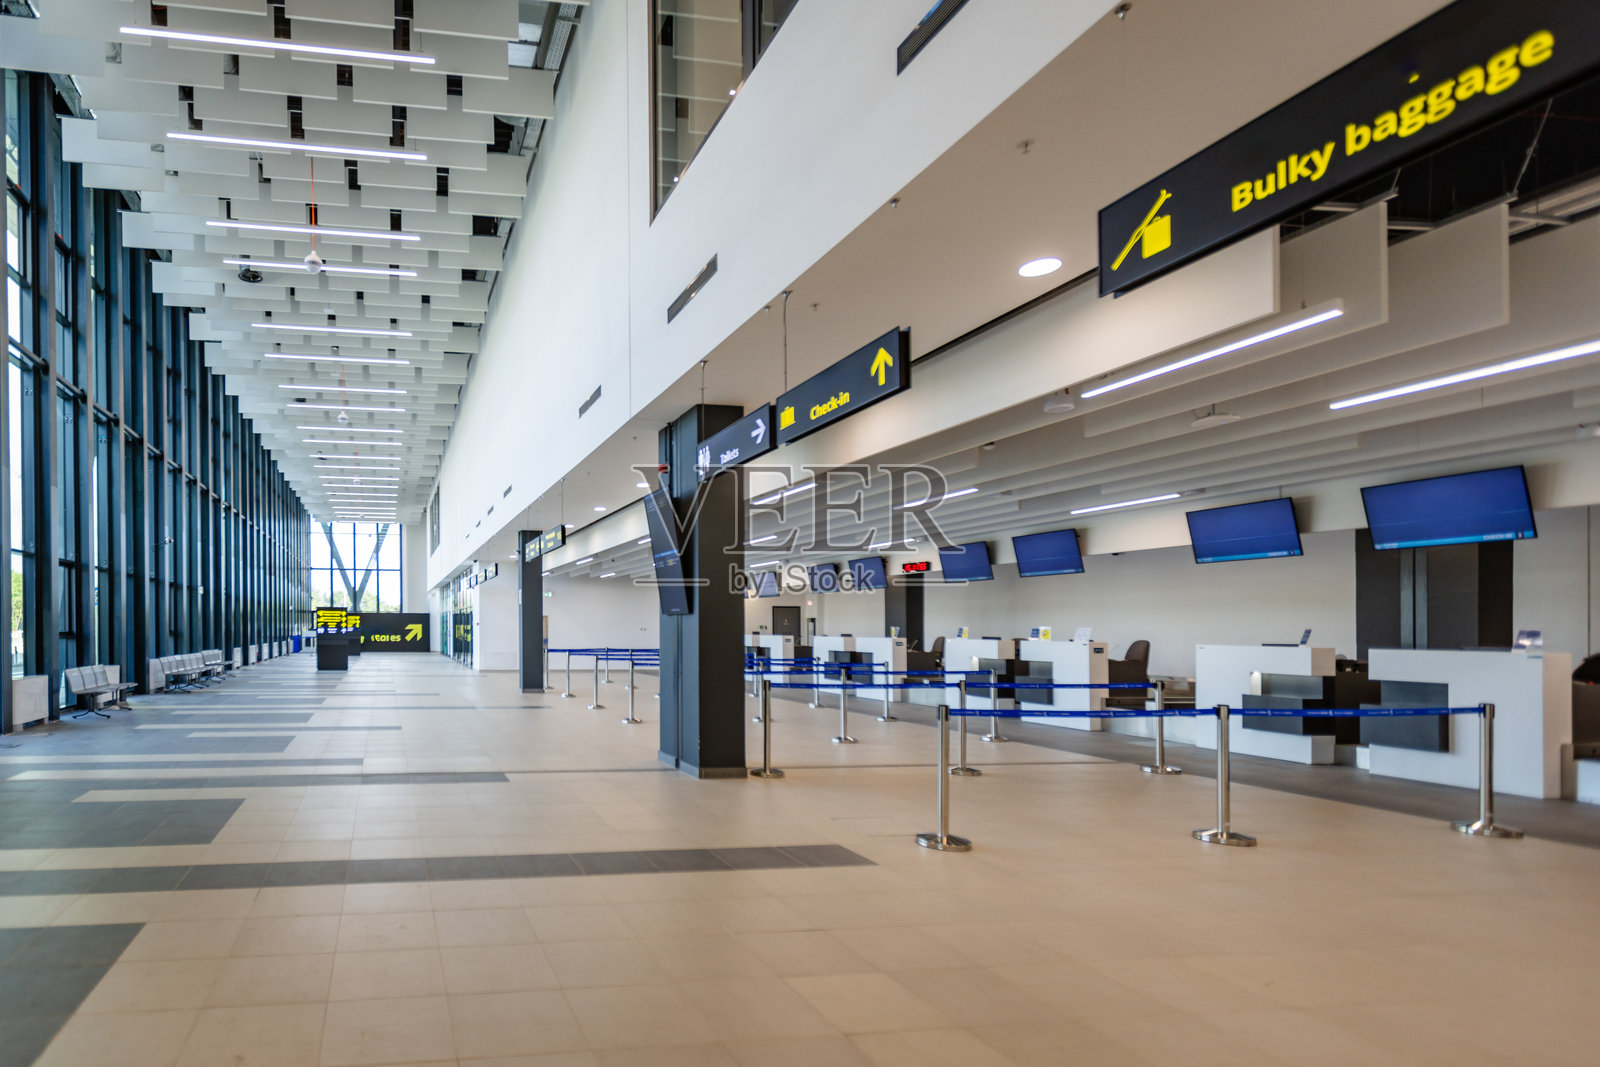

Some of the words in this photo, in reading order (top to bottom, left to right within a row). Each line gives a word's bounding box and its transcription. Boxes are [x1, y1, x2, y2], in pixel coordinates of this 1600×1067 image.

[1230, 142, 1335, 212] Bulky
[1345, 30, 1554, 156] baggage
[810, 392, 850, 420] Check-in
[720, 448, 739, 464] Toilets
